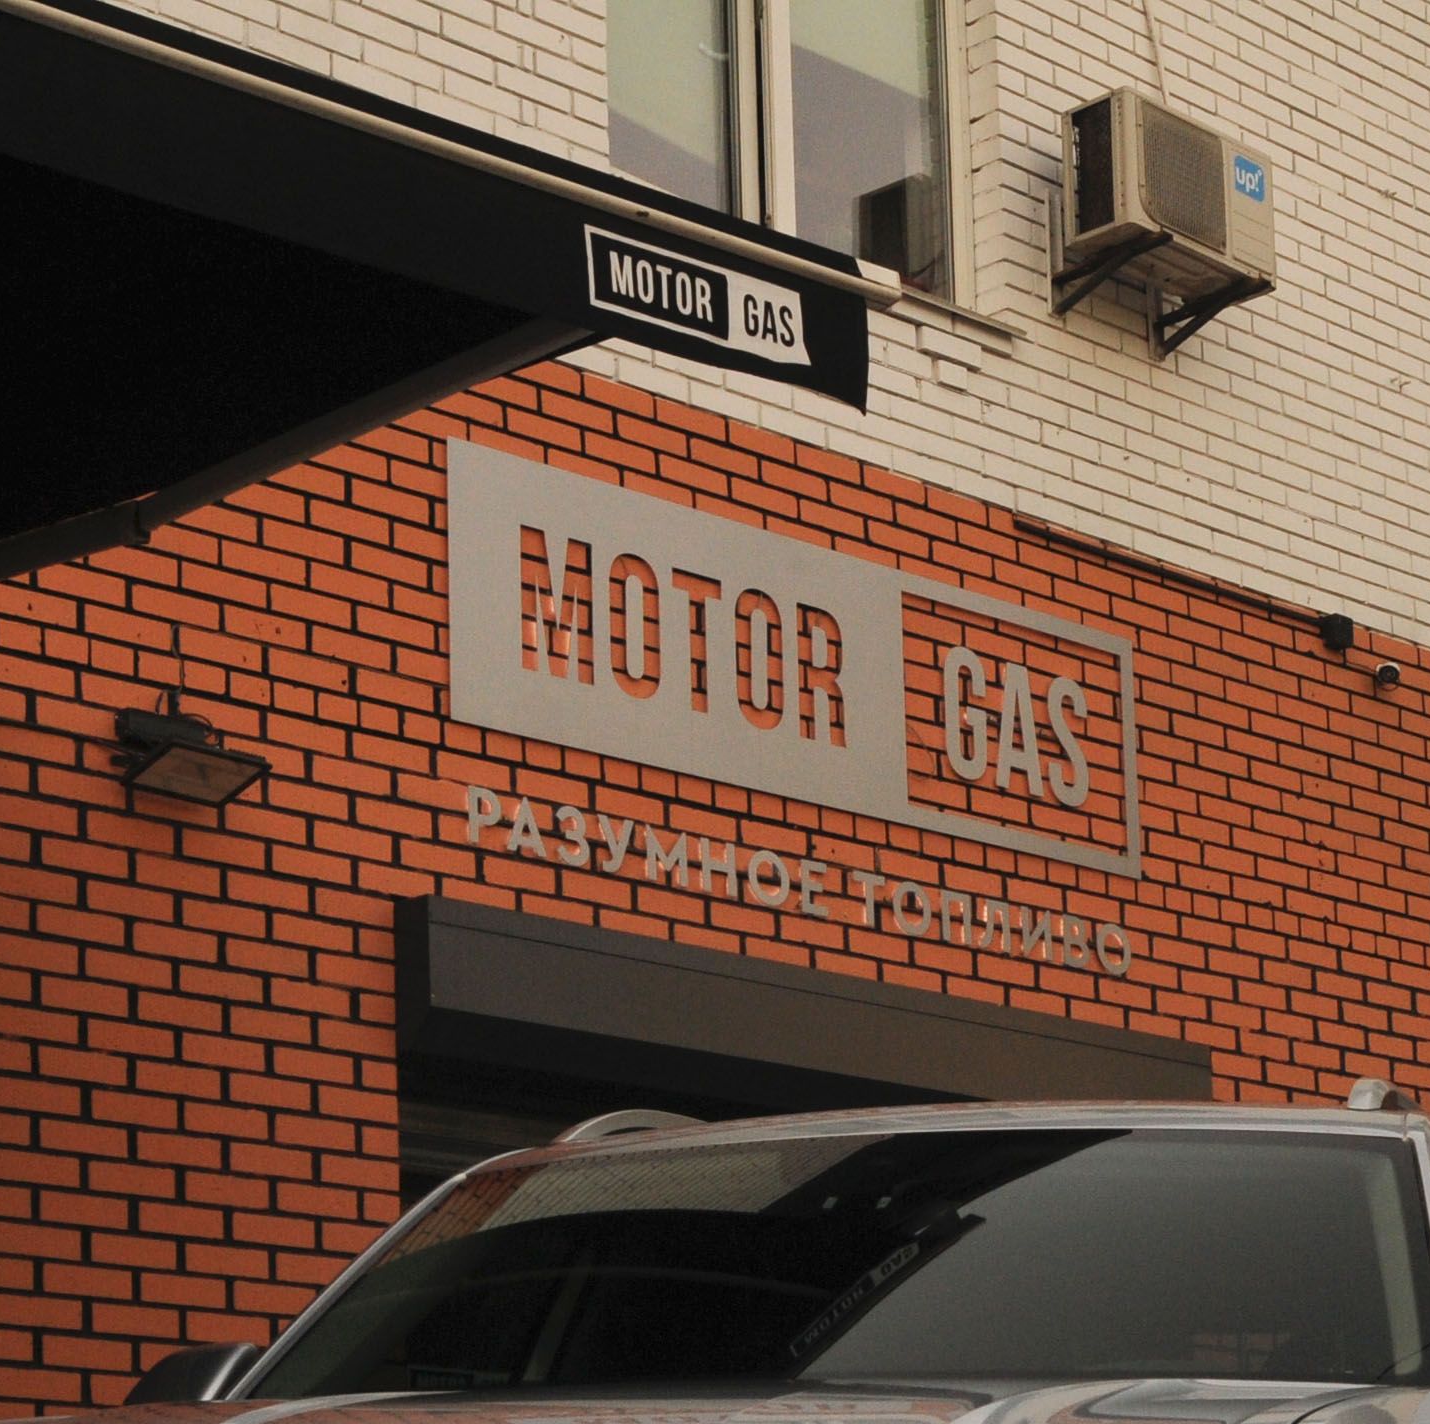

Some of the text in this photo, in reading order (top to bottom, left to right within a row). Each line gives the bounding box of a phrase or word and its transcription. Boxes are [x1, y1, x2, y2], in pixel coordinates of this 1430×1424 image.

[609, 249, 797, 348] MOTOR GAS
[519, 524, 1091, 809] MOTOR GAS
[465, 784, 1134, 977] РАЗУМНОЕ ТОПЛИВО
